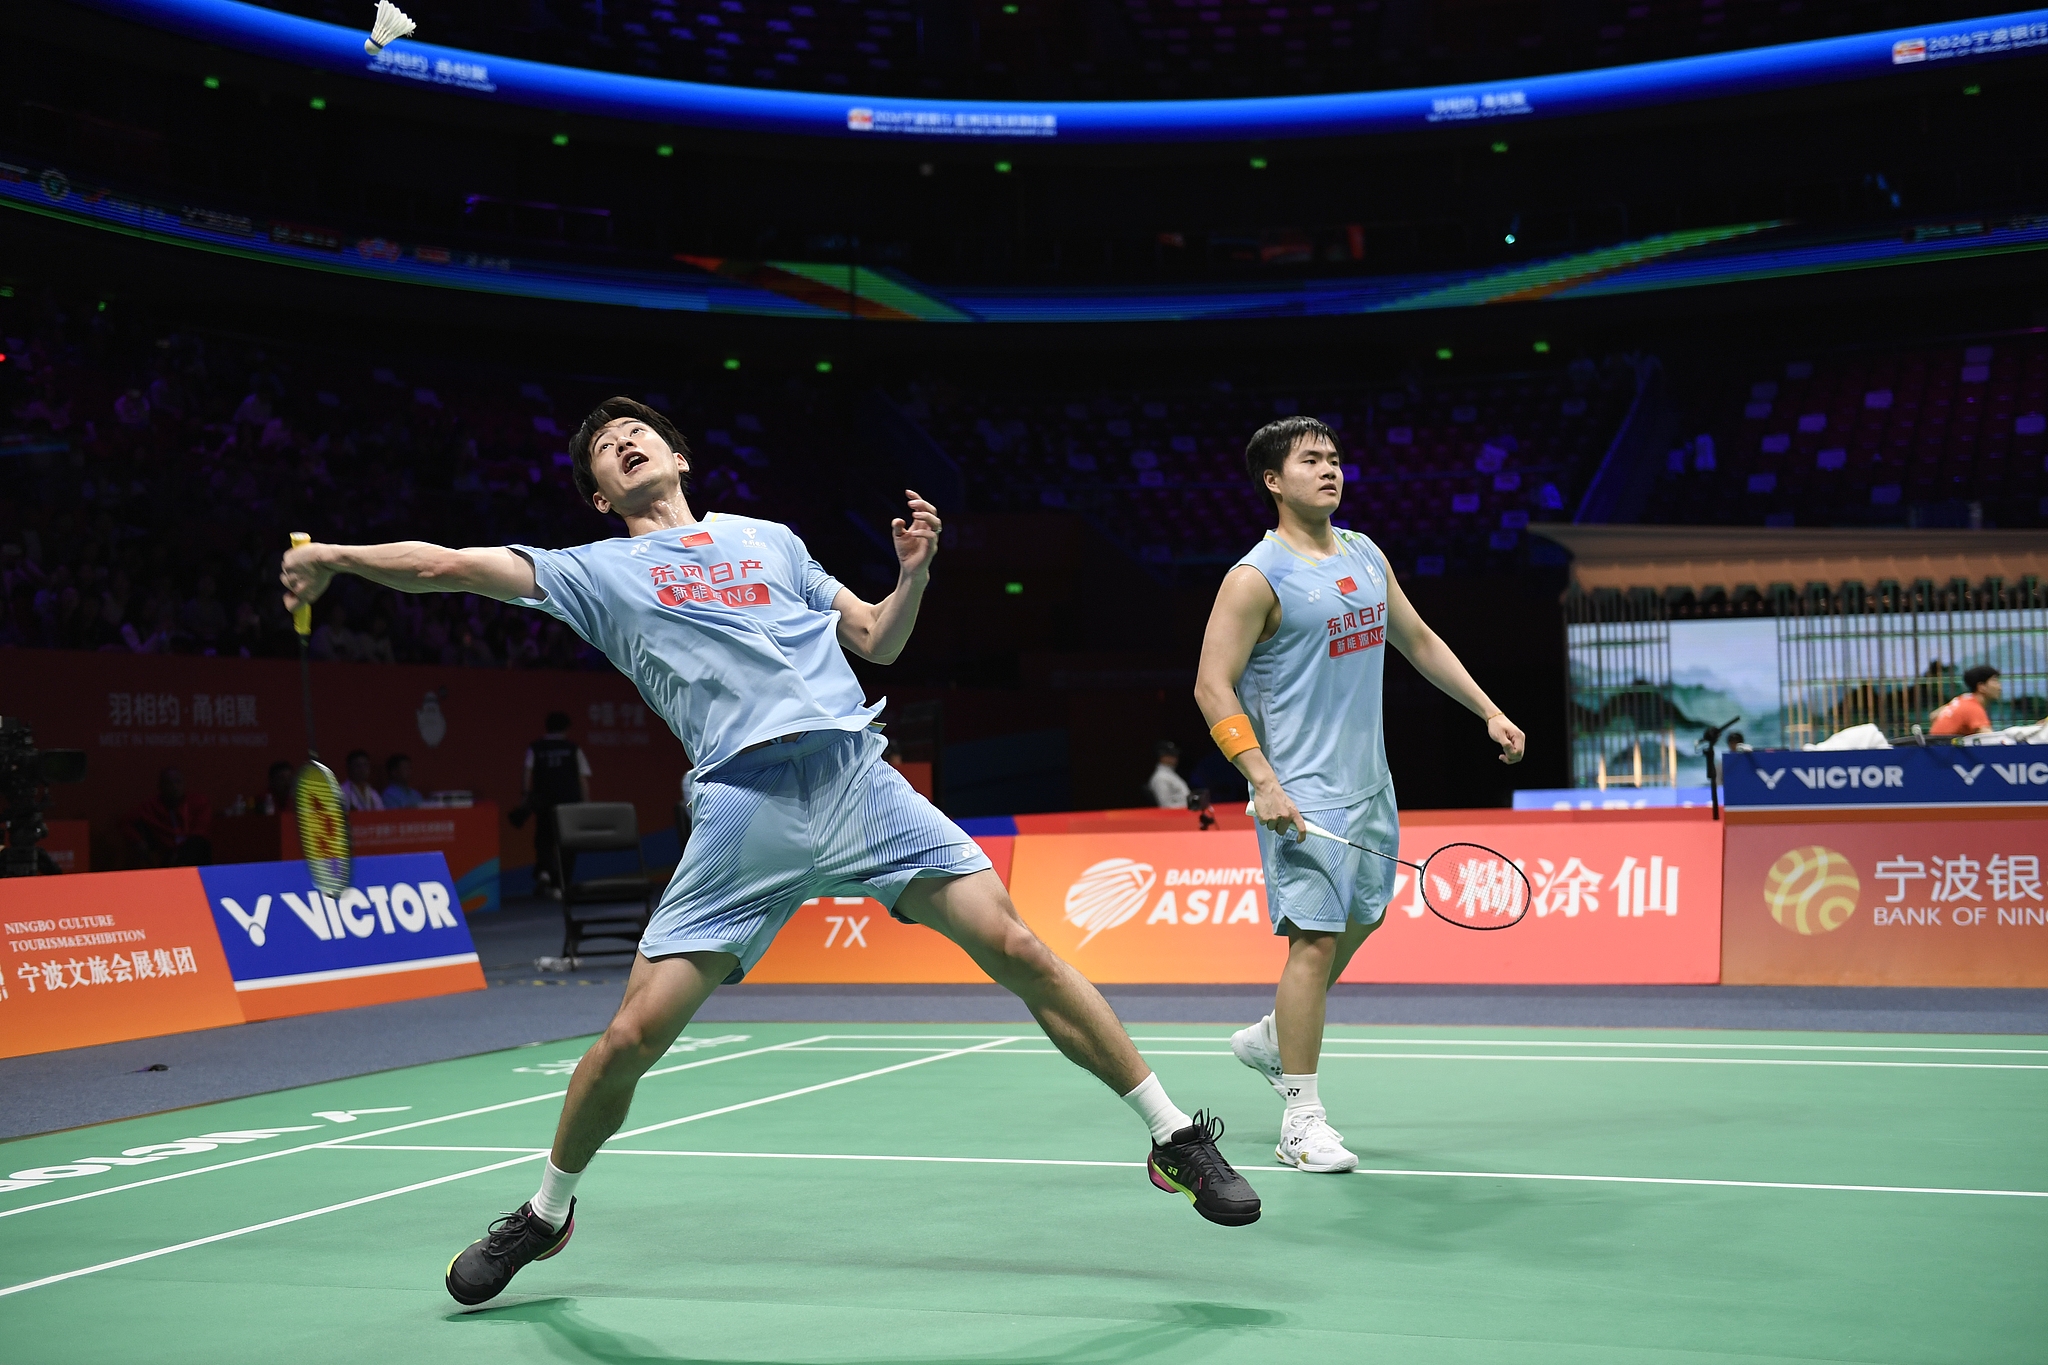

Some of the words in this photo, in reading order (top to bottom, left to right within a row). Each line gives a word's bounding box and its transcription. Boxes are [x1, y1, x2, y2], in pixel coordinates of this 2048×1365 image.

[649, 560, 763, 586] 东风日产
[1327, 602, 1385, 636] 东风日产
[1792, 765, 1903, 789] VICTOR
[1991, 762, 2048, 785] VIC
[1394, 856, 1679, 918] 小糊涂仙
[1874, 854, 2048, 902] 宁波银
[280, 881, 458, 940] VICTOR
[1146, 889, 1259, 924] ASIA
[1874, 907, 1941, 926] BANK
[1952, 907, 1987, 926] OF
[1997, 907, 2048, 926] NIN
[4, 918, 56, 935] NINGBO
[58, 914, 115, 930] CULTURE
[825, 916, 870, 948] 7X
[9, 929, 146, 953] TOURISM&EXHIBITION
[17, 946, 197, 993] 宁波文旅会展集团
